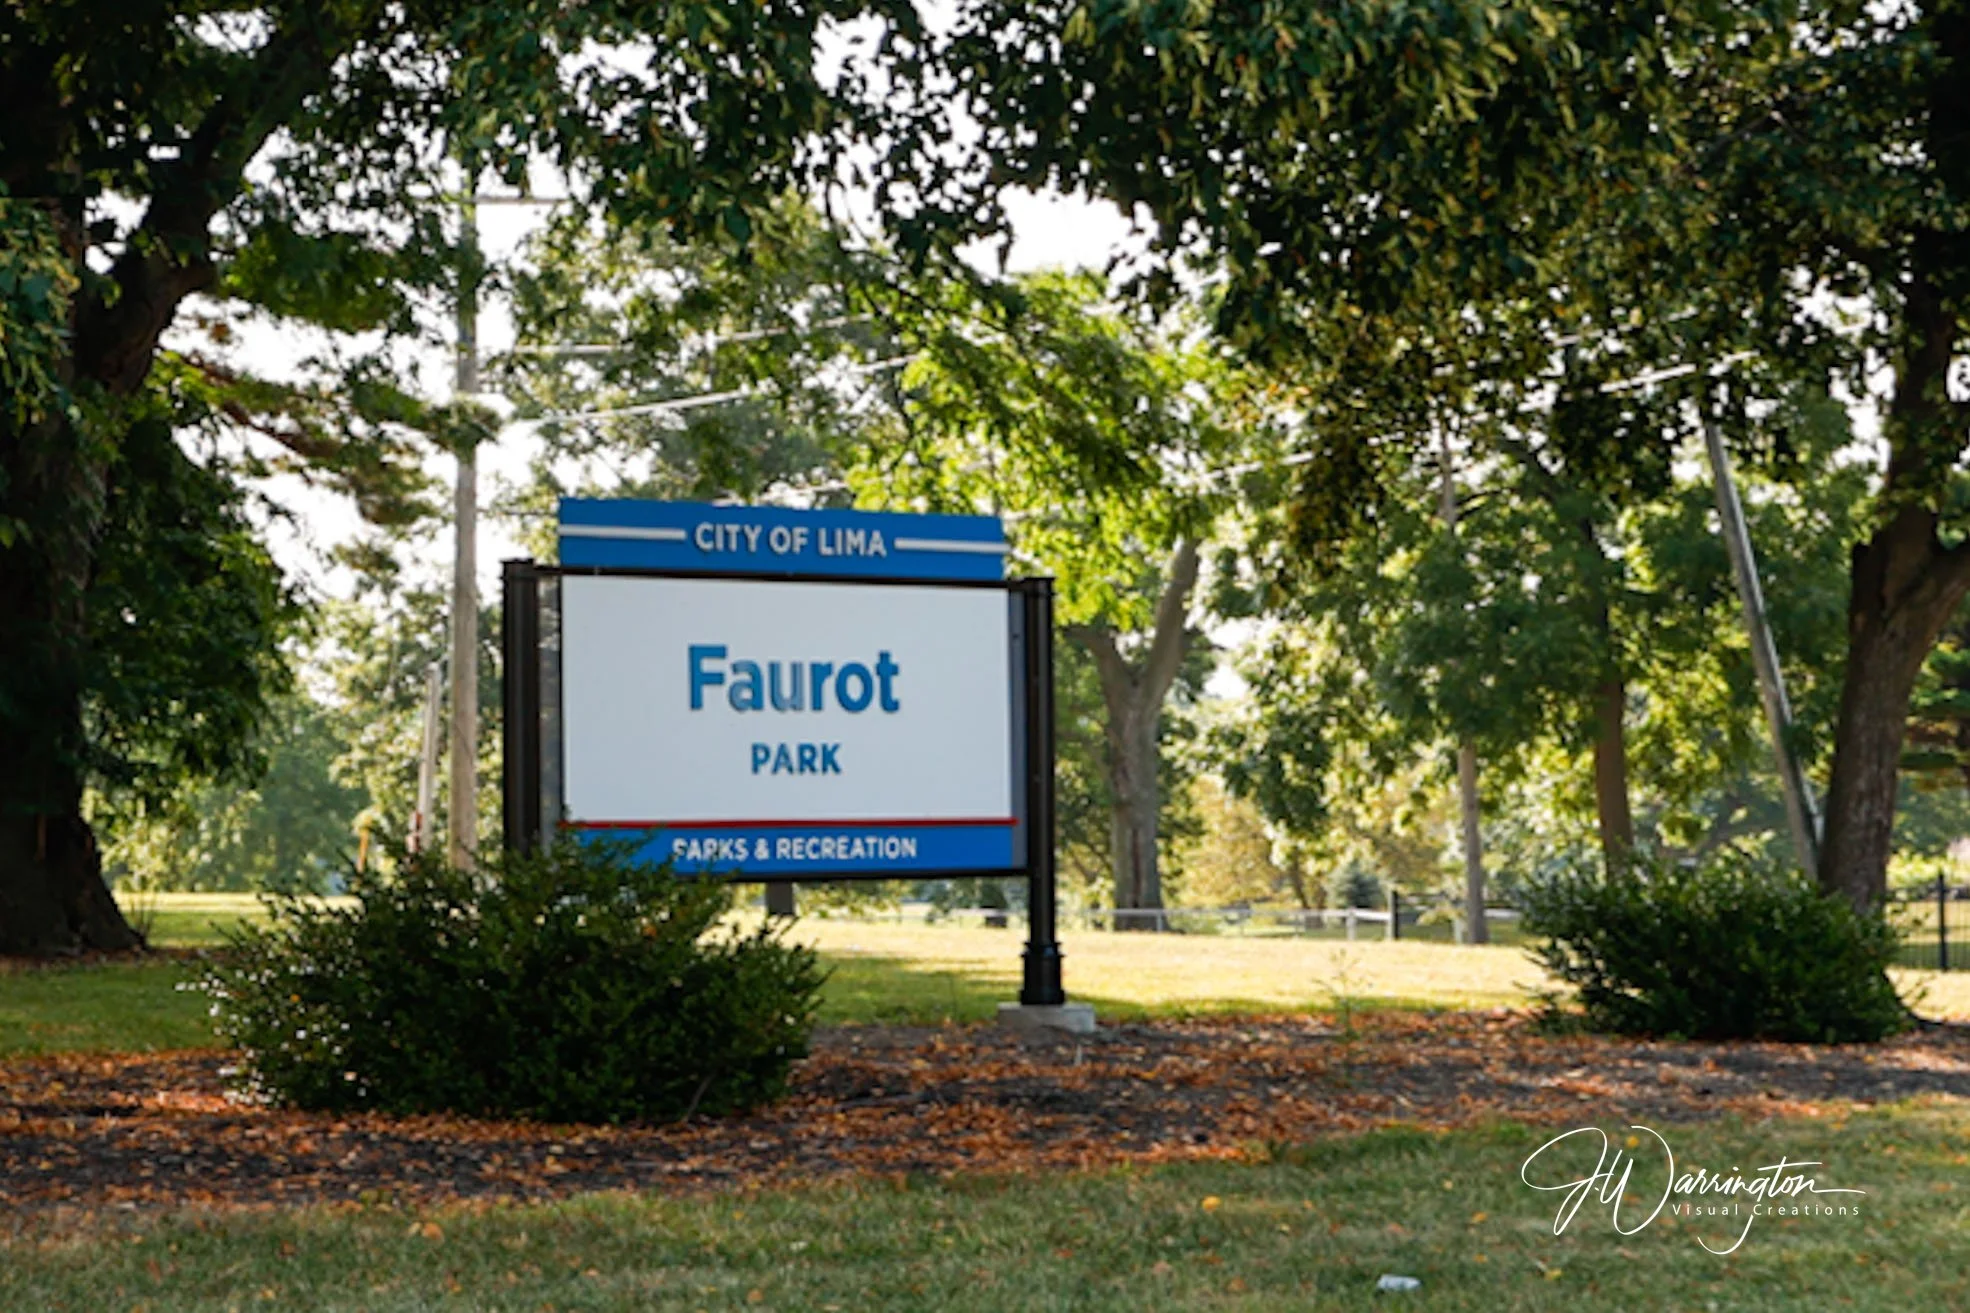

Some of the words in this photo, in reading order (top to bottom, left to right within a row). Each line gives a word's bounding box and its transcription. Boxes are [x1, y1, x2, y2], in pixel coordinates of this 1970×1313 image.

[695, 523, 763, 554] CITY
[768, 526, 808, 555] OF
[817, 528, 888, 557] LIMA
[688, 643, 902, 714] Faurot
[751, 742, 843, 775] PARK
[754, 838, 770, 860] &
[776, 836, 918, 861] RECREATION
